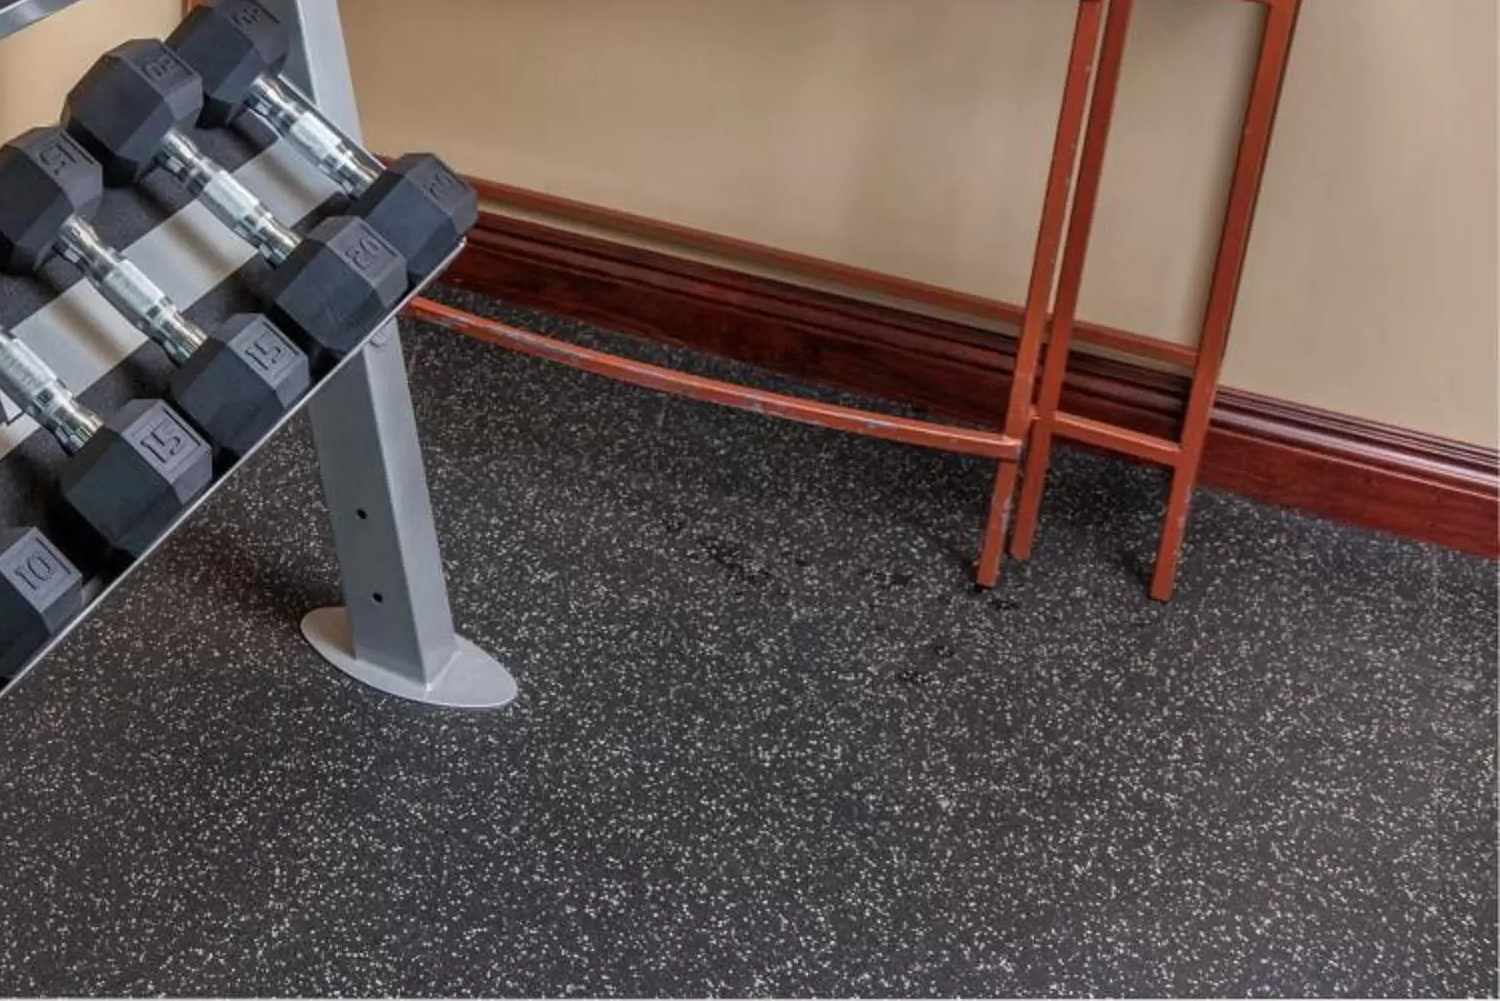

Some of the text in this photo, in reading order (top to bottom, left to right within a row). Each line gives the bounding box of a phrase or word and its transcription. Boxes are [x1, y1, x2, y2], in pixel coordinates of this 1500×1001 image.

[245, 330, 283, 372] 15
[140, 417, 183, 465] 15
[13, 550, 58, 593] 10
